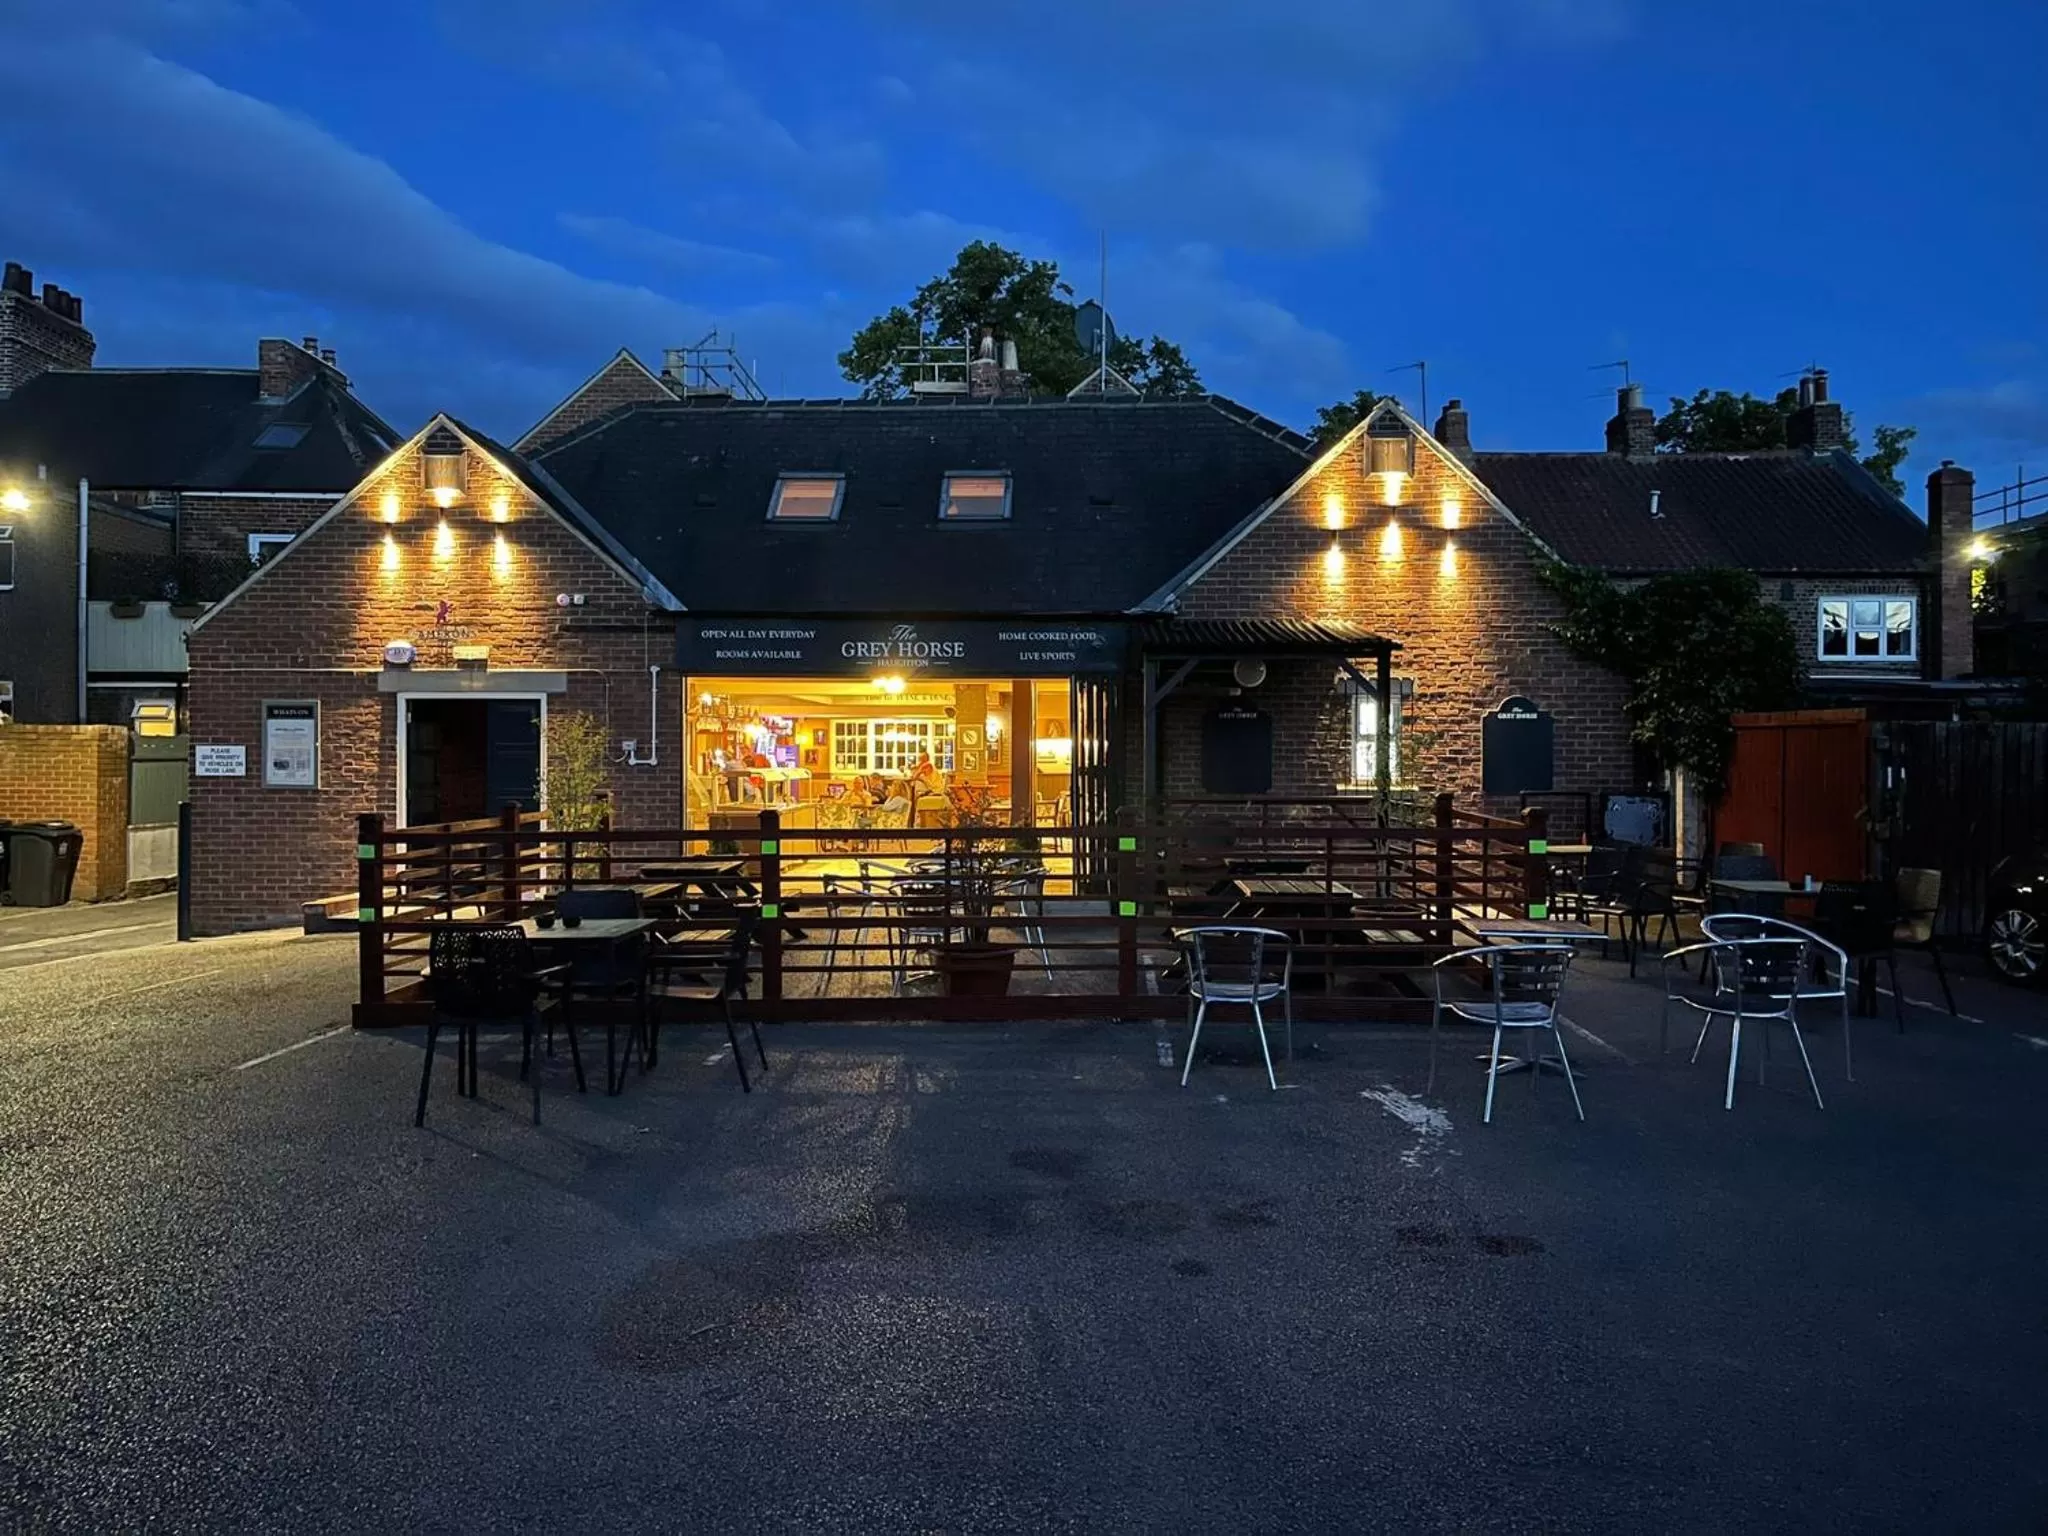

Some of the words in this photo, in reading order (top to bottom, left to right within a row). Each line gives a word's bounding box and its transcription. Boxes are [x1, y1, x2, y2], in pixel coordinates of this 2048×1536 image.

[701, 630, 727, 639] OPEN
[729, 630, 747, 639] ALL
[748, 630, 767, 639] DAY
[769, 630, 816, 639] EVERYDAY
[889, 624, 918, 641] The
[998, 632, 1027, 641] HOME
[1028, 632, 1069, 641] COOKED
[1070, 632, 1097, 641] FOOD
[841, 641, 892, 658] GREY
[898, 641, 965, 658] HORSE
[716, 650, 750, 659] ROOMS
[751, 650, 802, 659] AVAILABLE
[1019, 651, 1040, 661] LIVE
[1040, 651, 1076, 661] SPORTS
[877, 659, 929, 668] HAUGHTON
